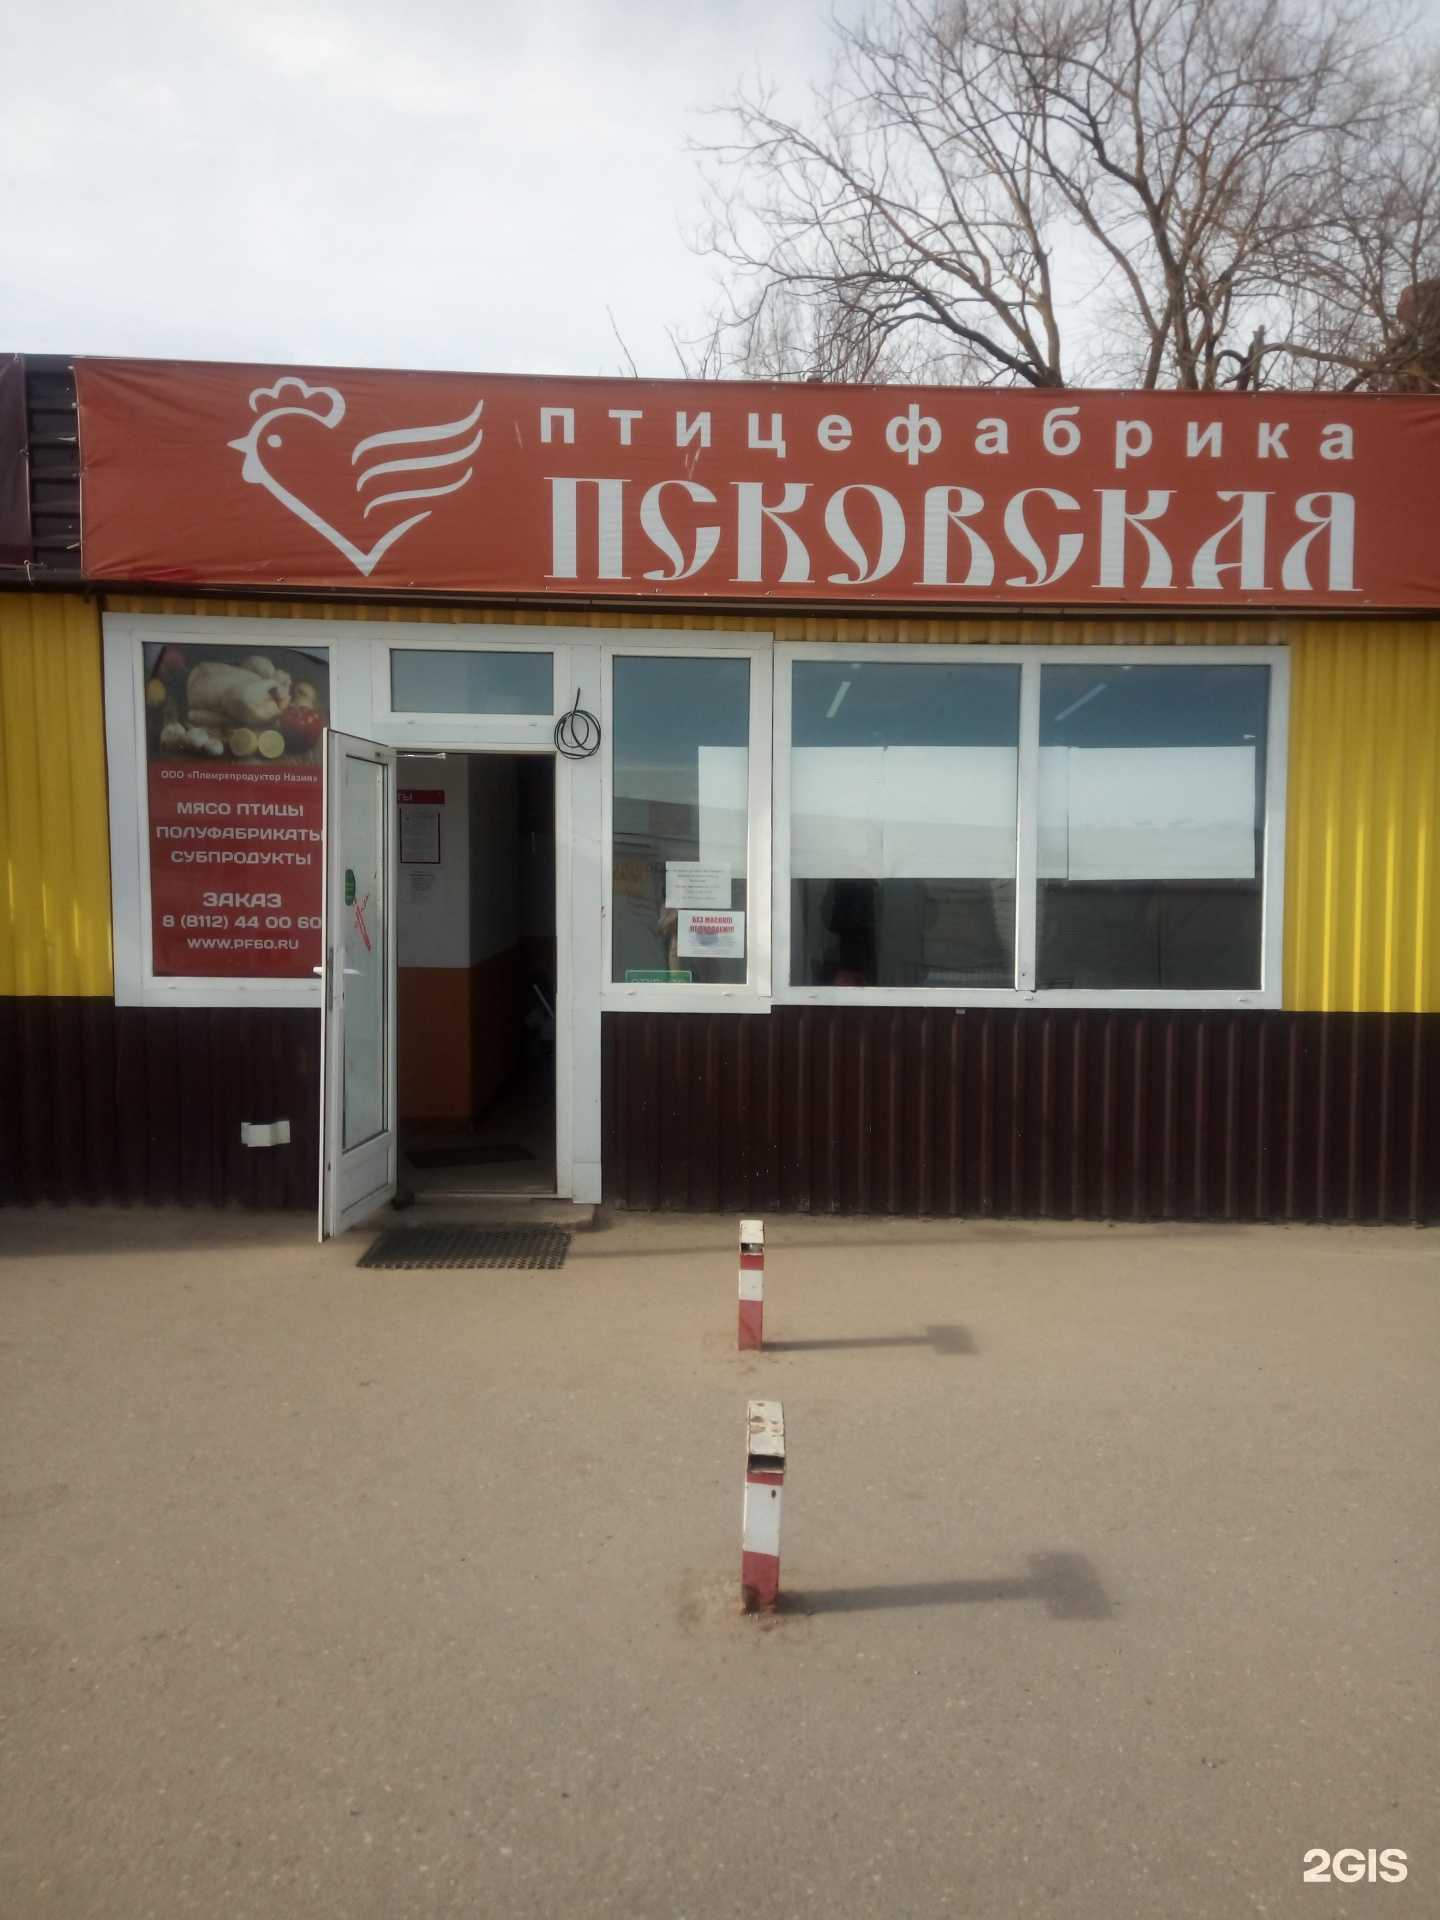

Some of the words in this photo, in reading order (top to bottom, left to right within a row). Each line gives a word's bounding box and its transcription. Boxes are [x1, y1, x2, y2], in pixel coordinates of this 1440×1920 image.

[539, 403, 1355, 469] птицефабрика
[543, 476, 1364, 592] ПСКОВСКАЯ
[160, 770, 185, 780] ООО
[176, 802, 231, 816] МЯСО
[236, 803, 304, 817] ПТИЦЫ
[156, 826, 324, 842] ПОЛУФАБРИКАТЫ
[170, 850, 312, 865] СУБПРОДУКТЫ
[202, 892, 283, 908] ЗАКАЗ
[162, 914, 175, 928] 8
[180, 914, 229, 930] (8112)
[234, 916, 260, 929] 44
[265, 916, 292, 929] 00
[297, 916, 322, 929] 60
